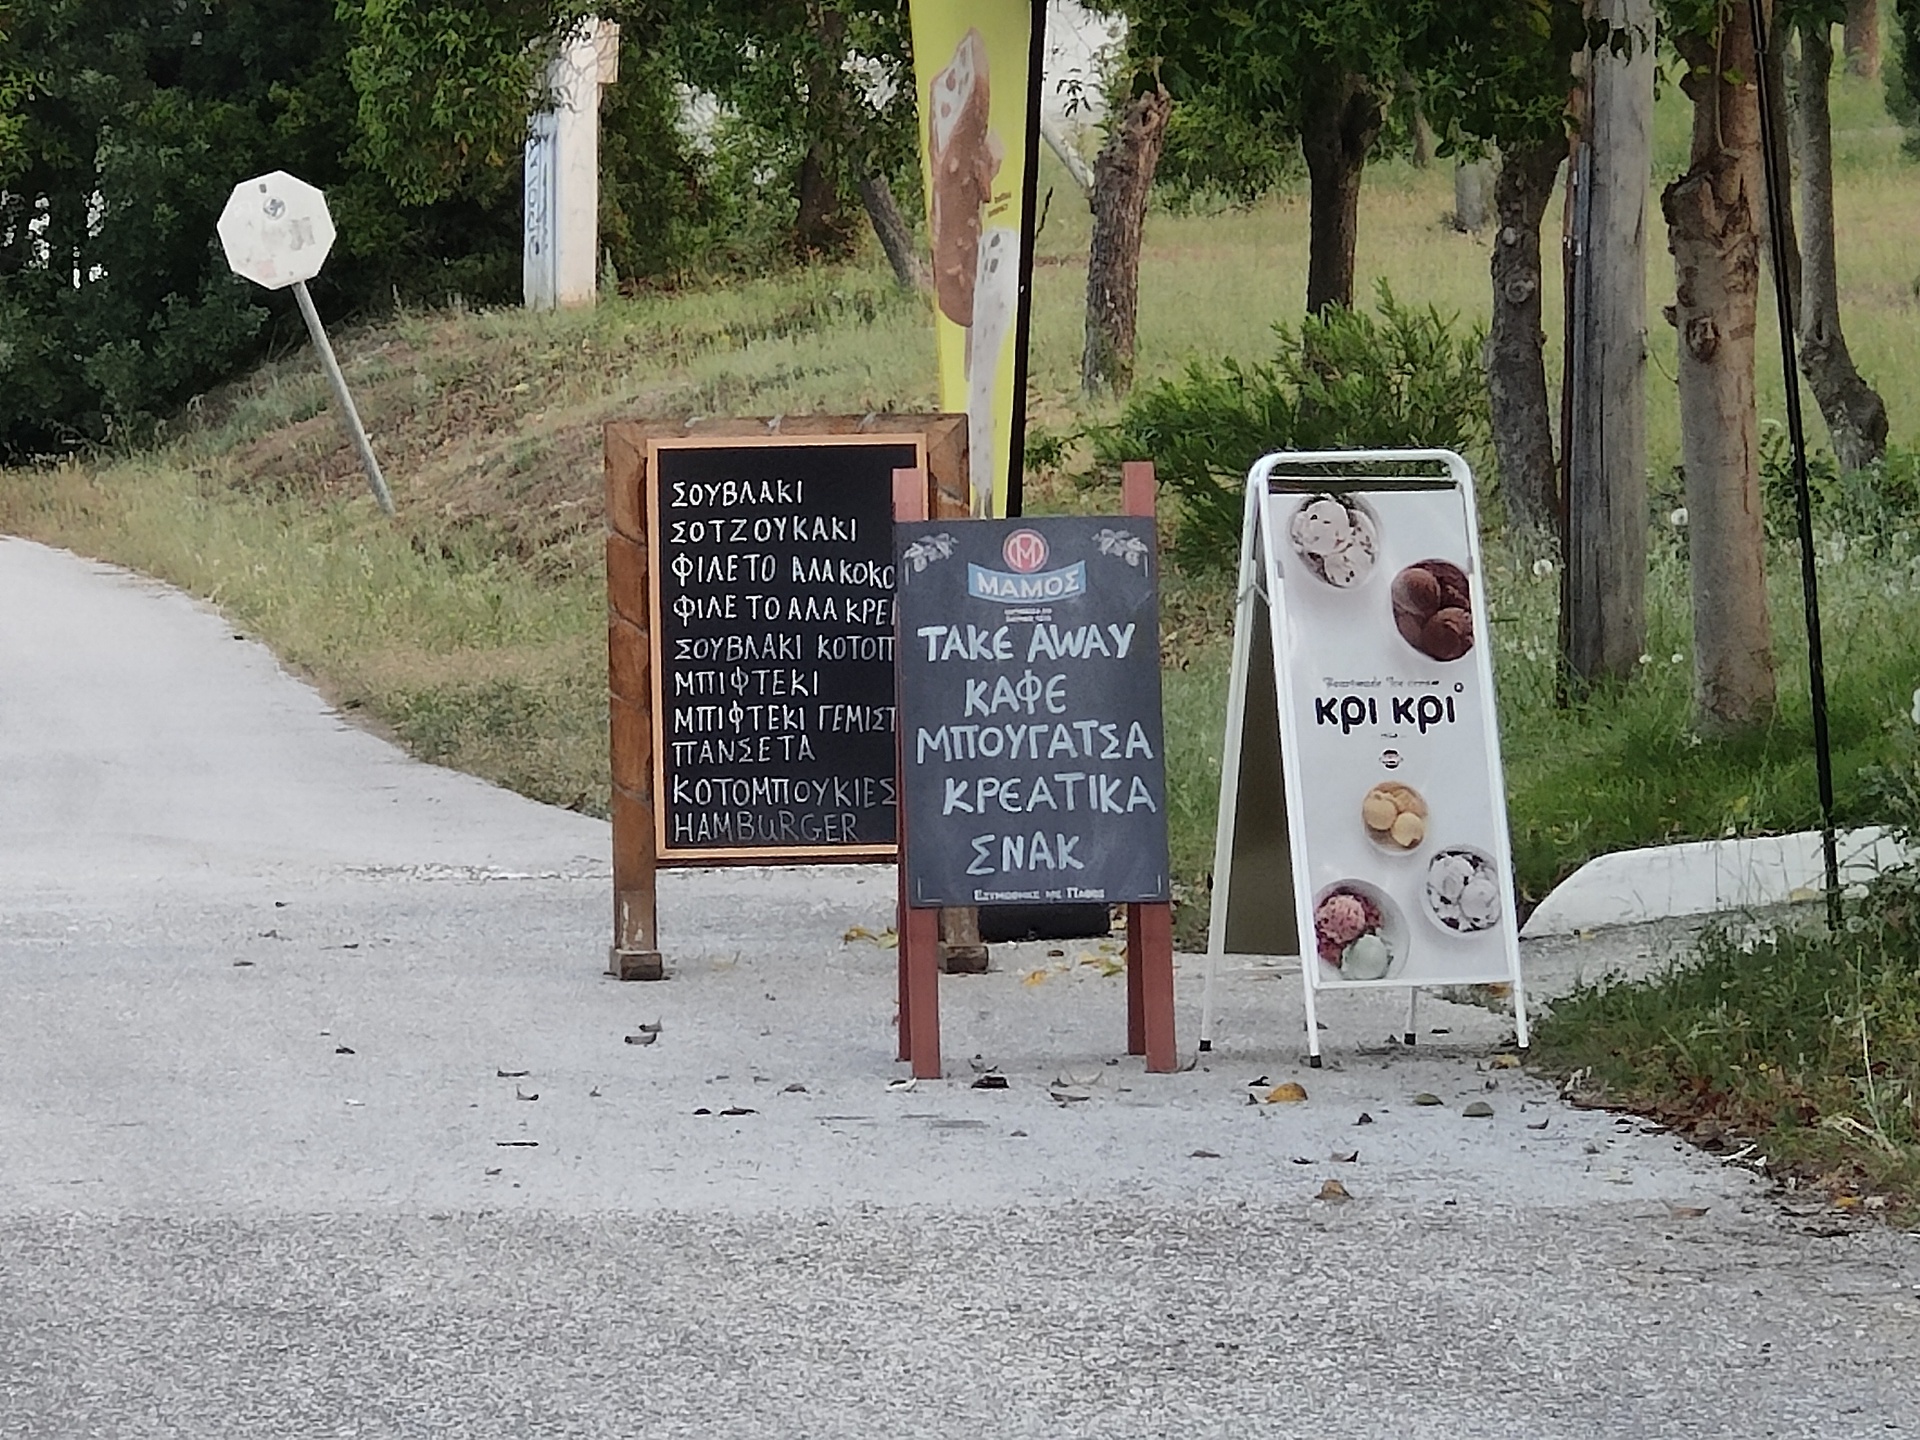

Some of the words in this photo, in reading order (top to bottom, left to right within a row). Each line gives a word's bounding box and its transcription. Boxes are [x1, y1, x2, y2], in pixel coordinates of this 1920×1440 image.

[671, 480, 802, 507] ΣΟΥΒΛΑΚΙ
[670, 516, 856, 544] ΣΟΤΖΟΥΚΑΚΙ
[977, 569, 1080, 598] ΜΑΜΟΣ
[675, 632, 801, 661] ΣΟΥΒΛΑΚΙ
[917, 624, 1014, 662] TAKE
[1027, 622, 1136, 663] AWAY
[674, 666, 819, 696] ΜΠΙΦΤΕΚΙ
[964, 669, 1067, 717] ΚΑΦΕ
[674, 700, 805, 733] ΜΠΙΦΤΕΚΙ
[917, 720, 1154, 764] ΜΠΟΥΓΑΤΣΑ
[673, 774, 896, 807] ΚΟΤΟΜΠΟΥΚΙΕΣ
[942, 773, 1157, 816] ΚΡΕΑΤΙΚΑ
[674, 810, 859, 842] HAMBURGER
[966, 831, 1085, 875] ΣΝΑΚ
